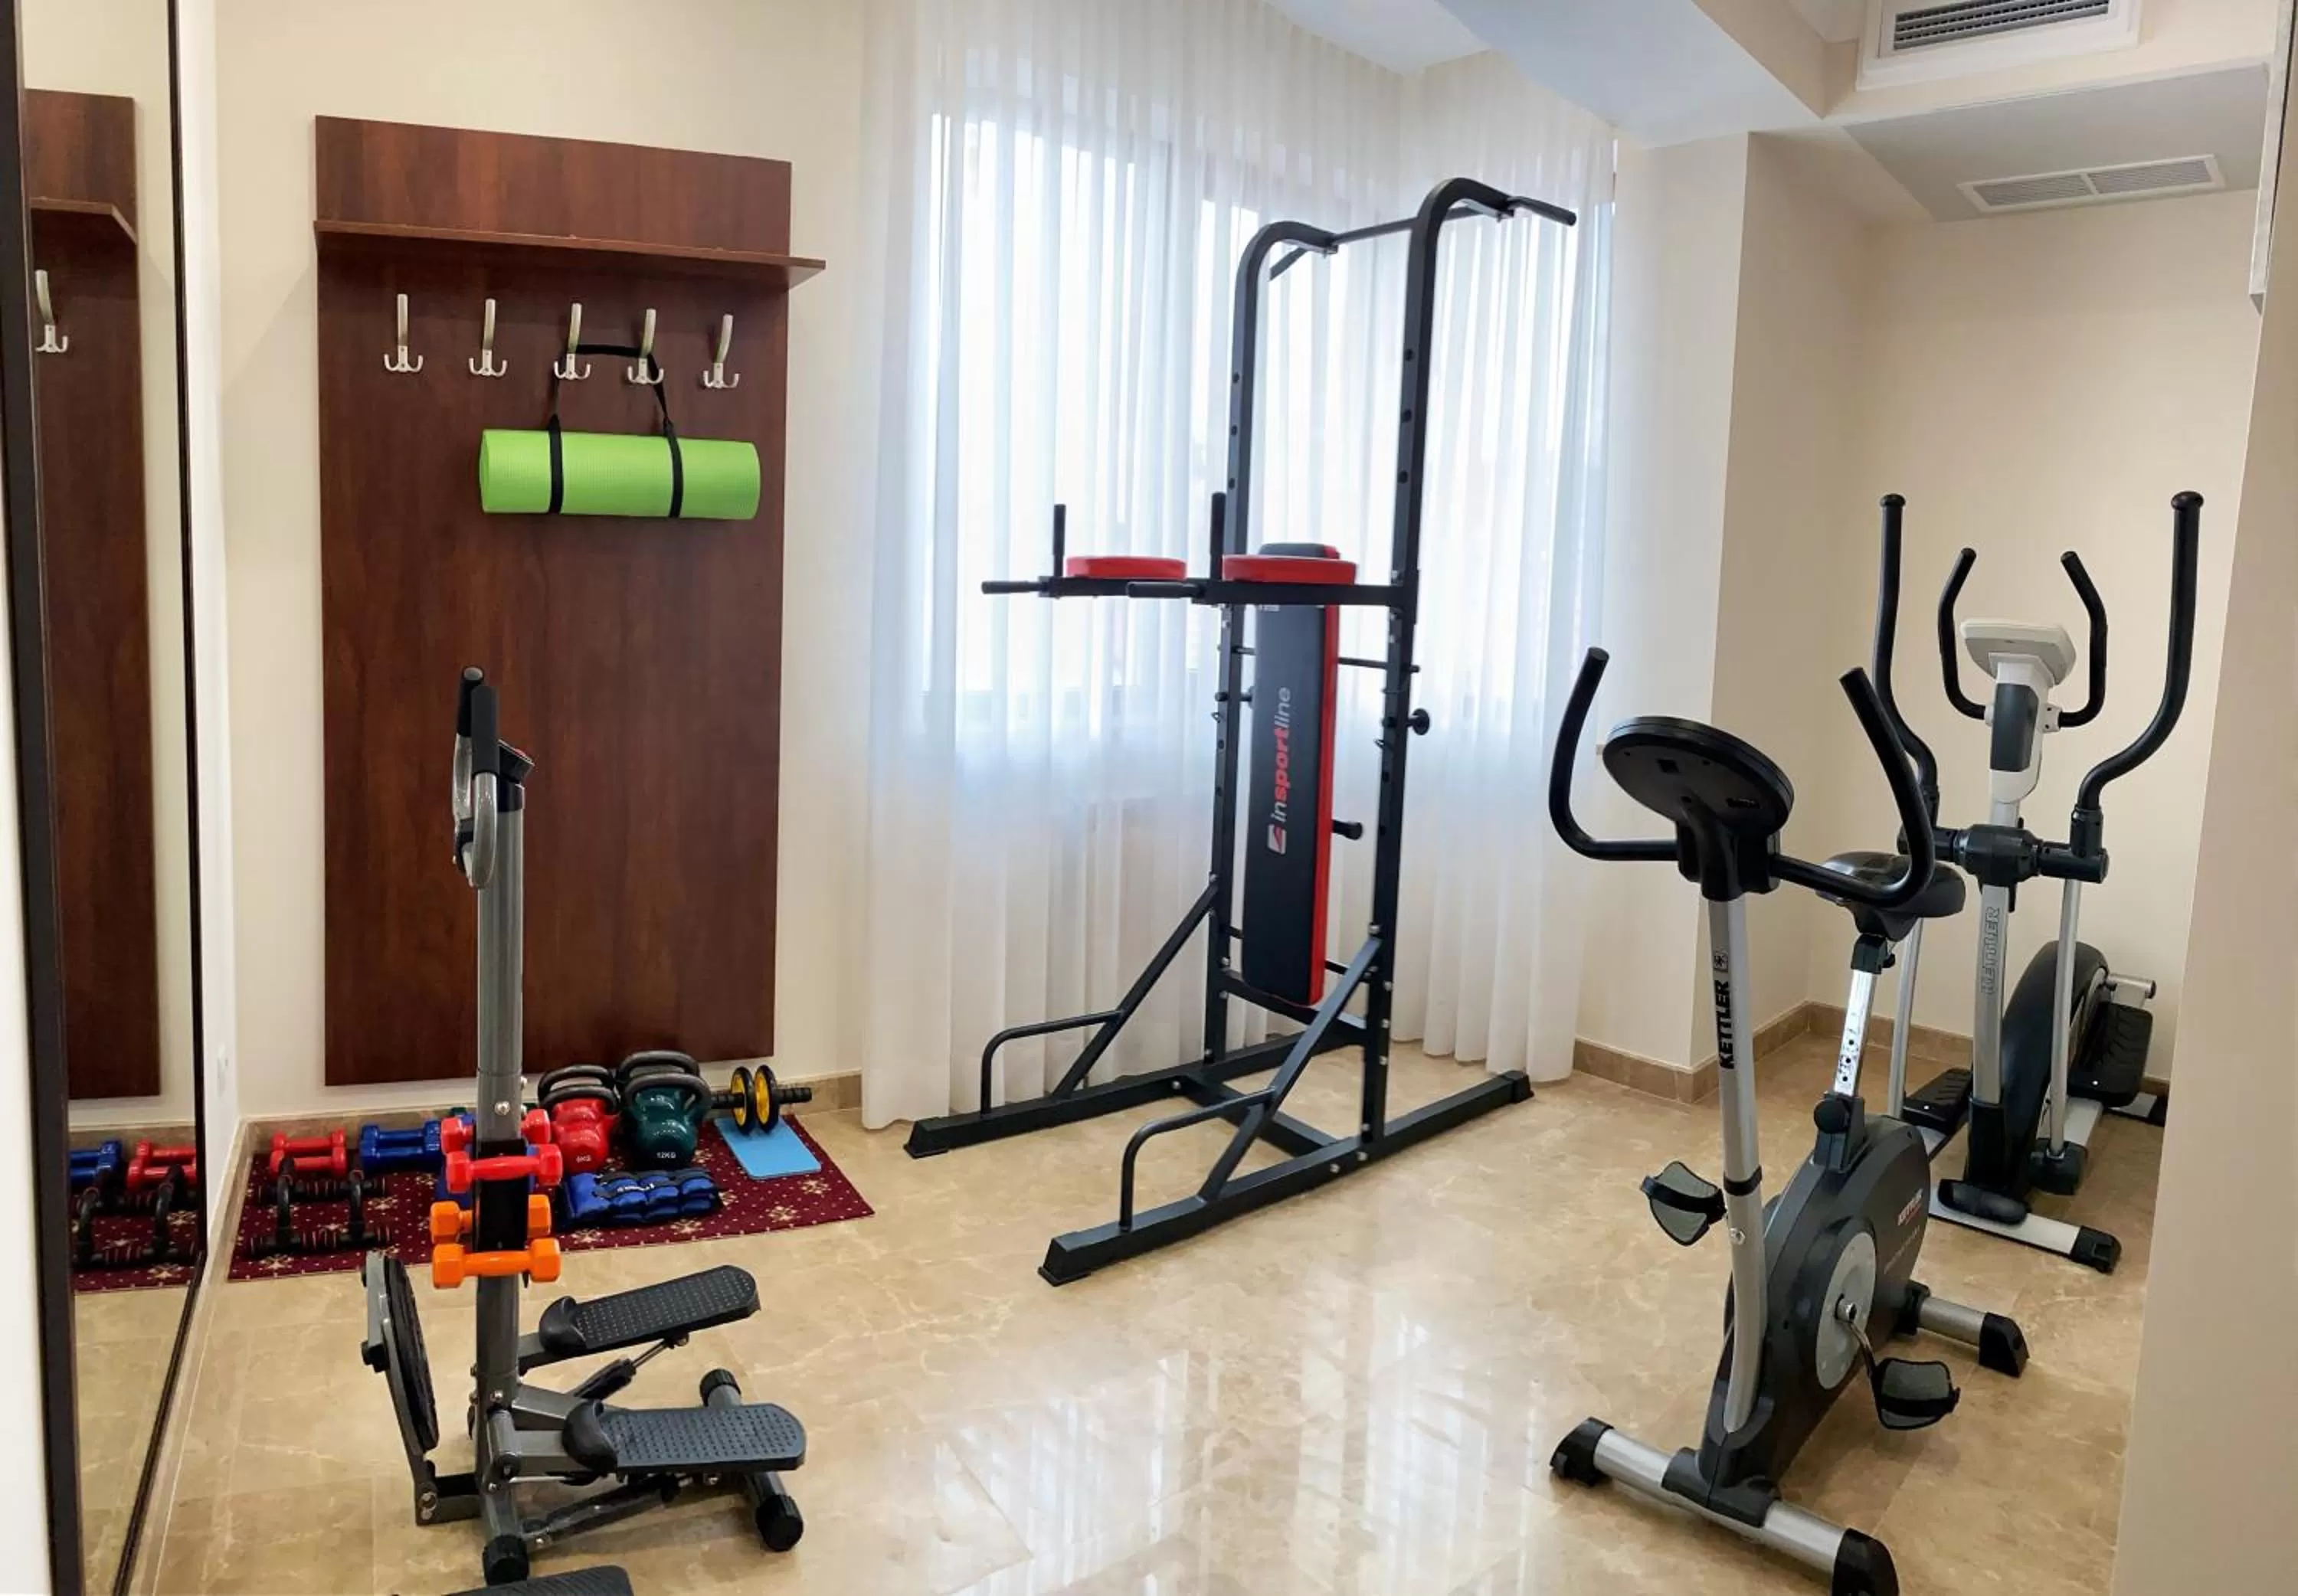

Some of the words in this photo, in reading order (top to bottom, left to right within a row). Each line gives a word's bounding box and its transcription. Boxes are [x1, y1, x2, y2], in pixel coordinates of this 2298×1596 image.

[1271, 687, 1291, 823] insportline
[1981, 907, 1999, 994] KETTLER
[1714, 980, 1735, 1070] KETTLER
